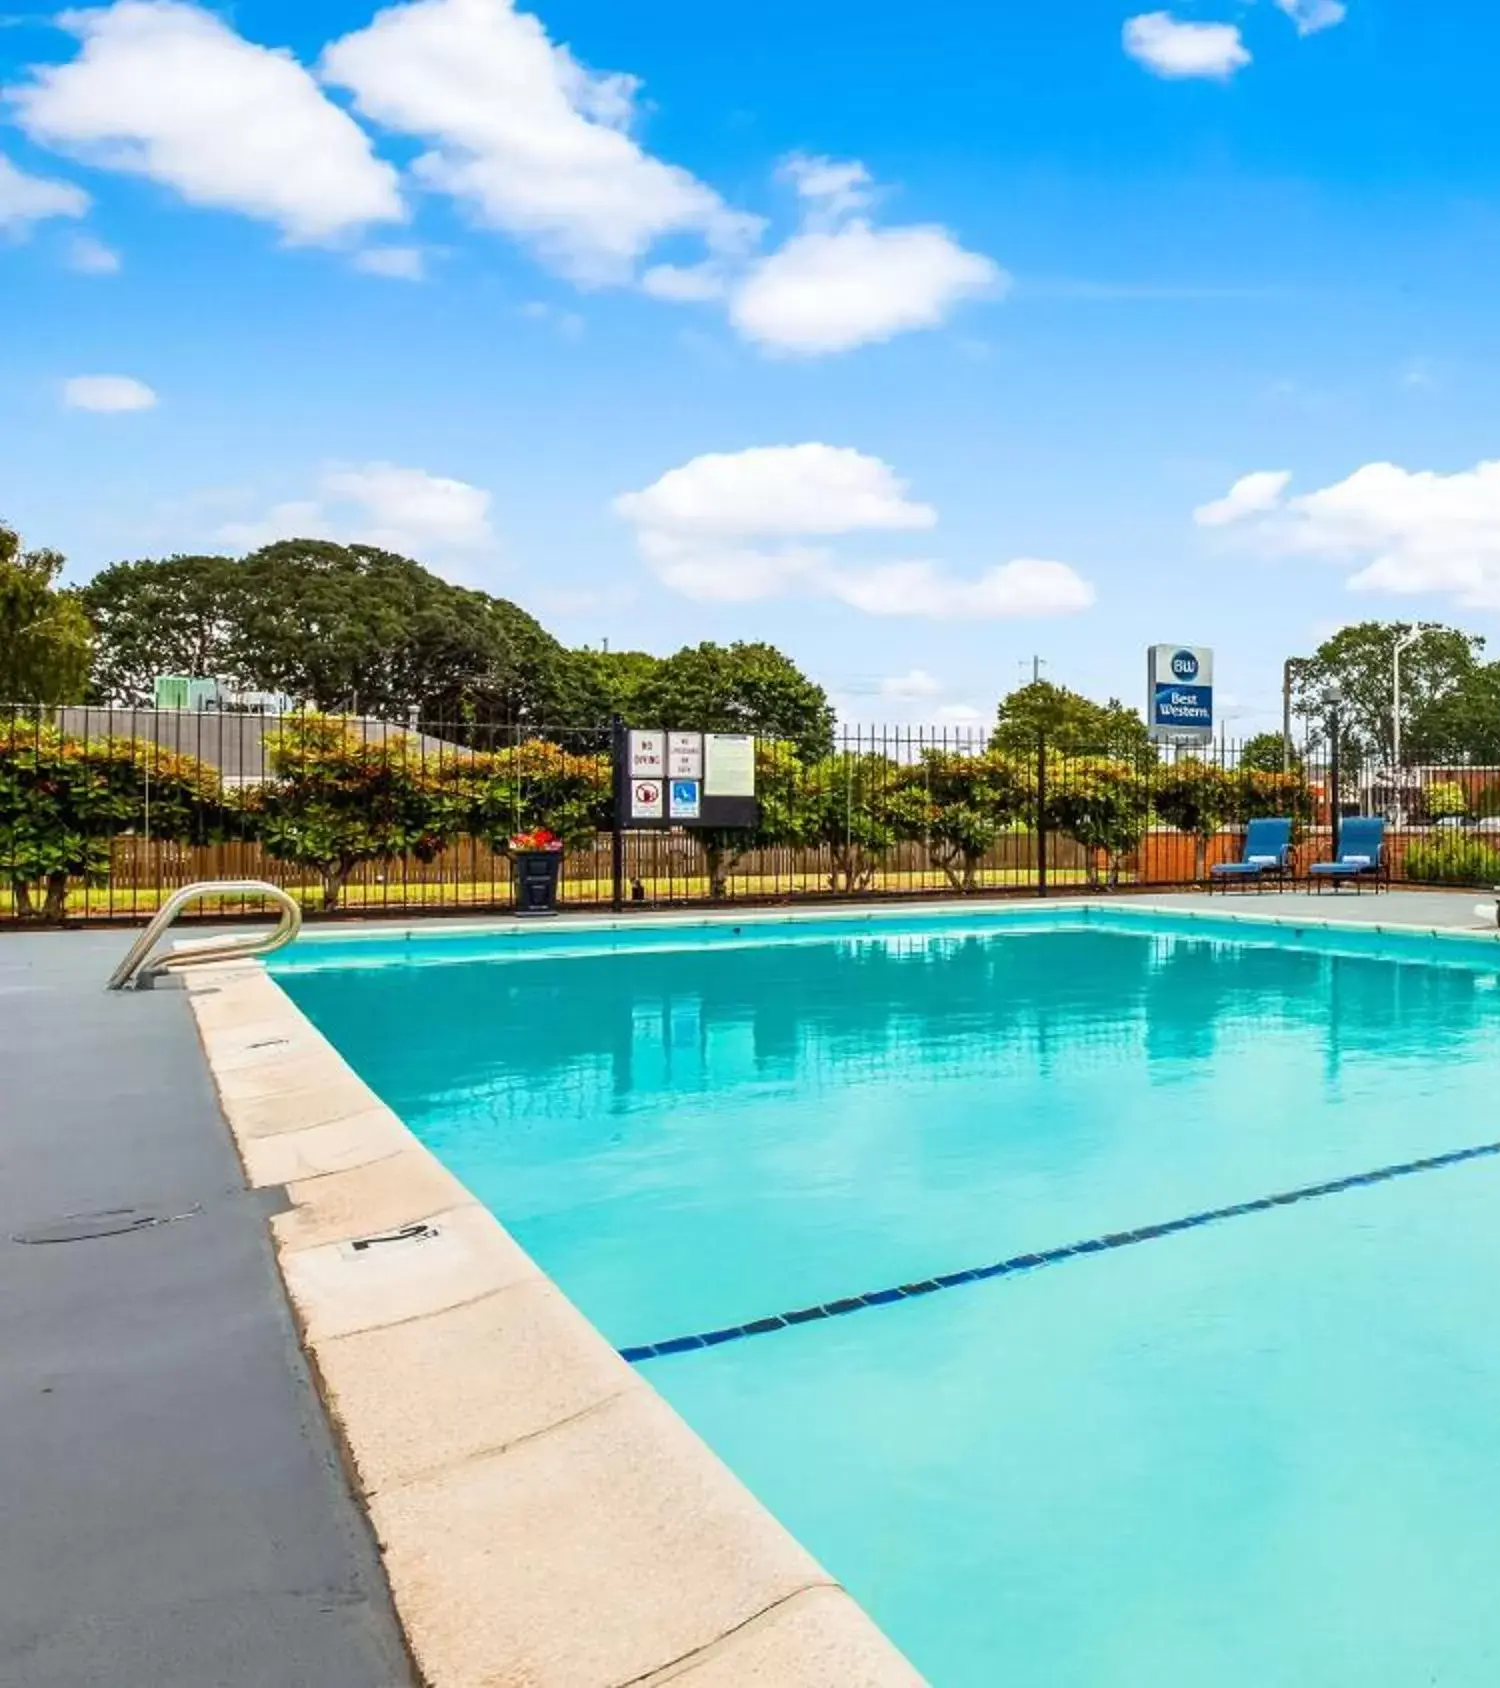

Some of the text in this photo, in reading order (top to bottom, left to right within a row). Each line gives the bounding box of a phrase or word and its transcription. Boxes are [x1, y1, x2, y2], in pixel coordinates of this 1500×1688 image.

[1174, 659, 1195, 672] BW
[1171, 691, 1197, 704] Best
[641, 740, 653, 750] NO
[634, 753, 660, 765] DIVING
